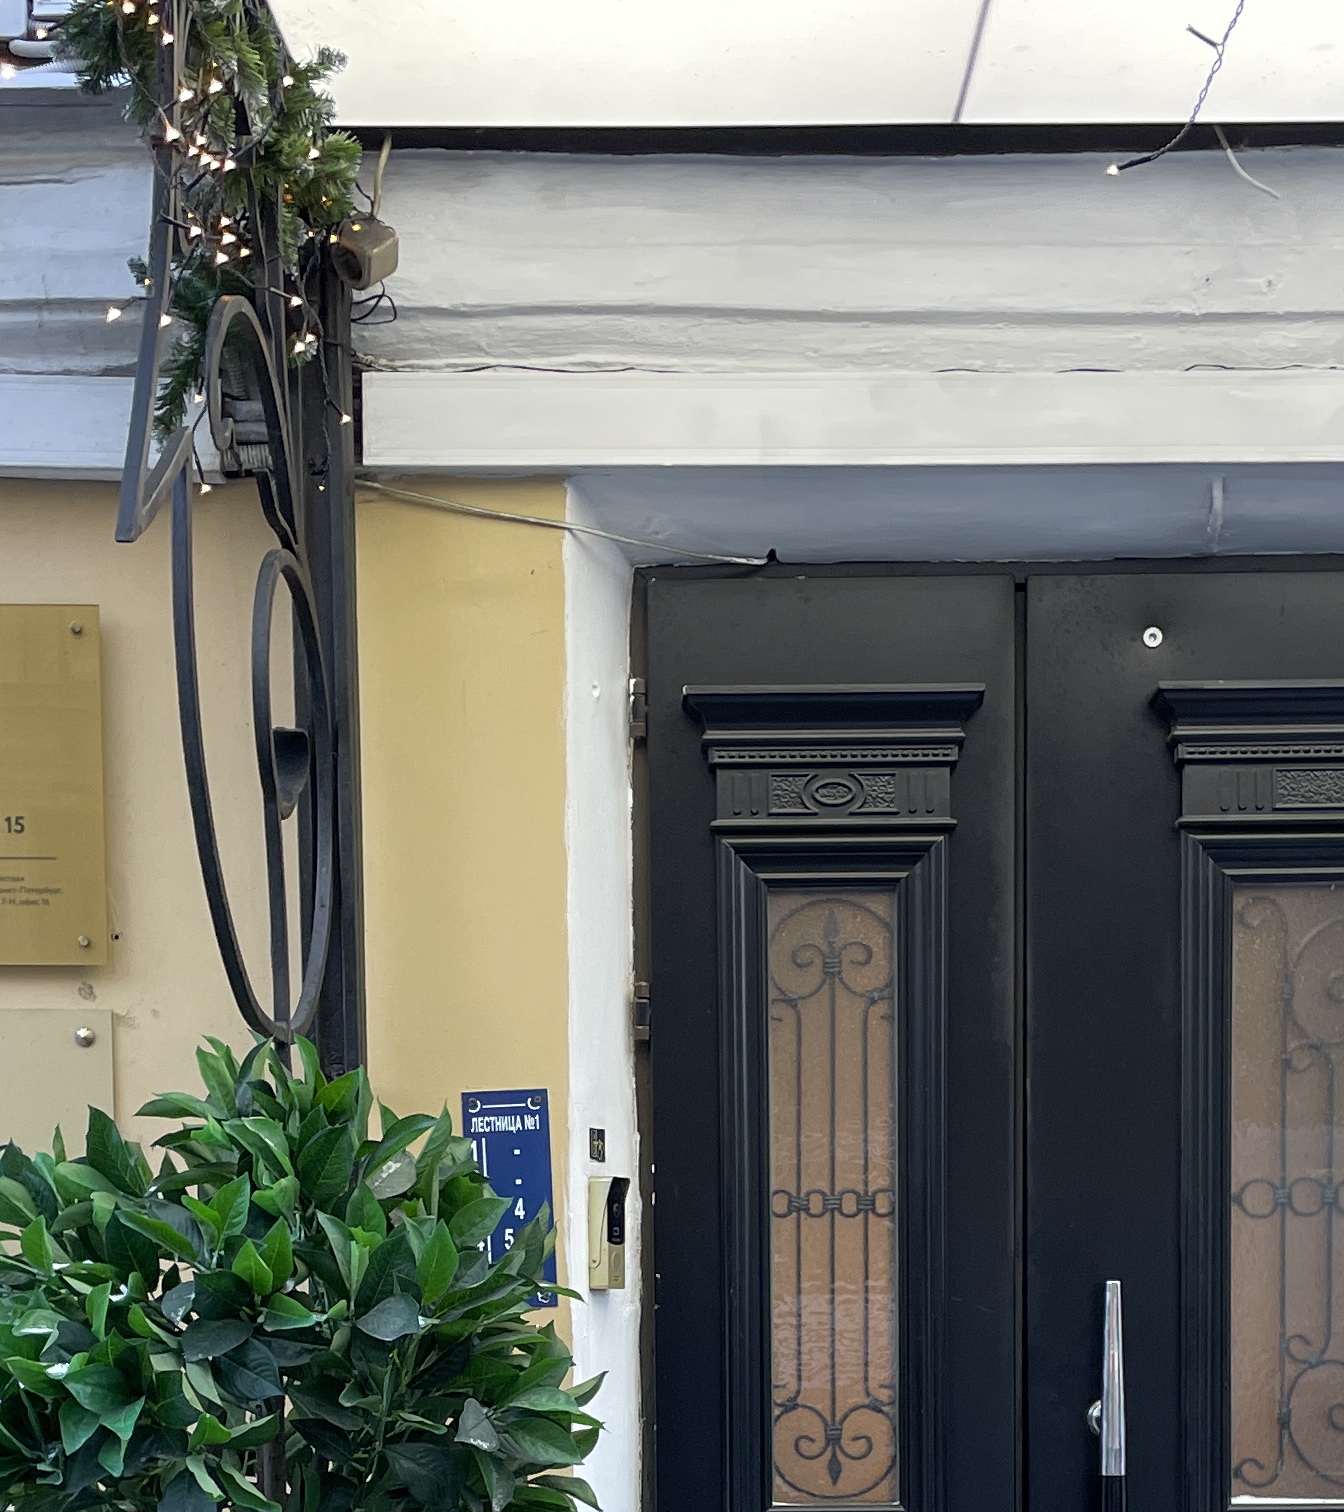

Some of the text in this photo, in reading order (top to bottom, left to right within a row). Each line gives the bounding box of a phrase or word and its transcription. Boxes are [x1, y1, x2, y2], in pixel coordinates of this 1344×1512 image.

[4, 816, 25, 834] 15
[470, 1115, 523, 1134] ЛЕСТНИЦА
[514, 1197, 526, 1220] 4
